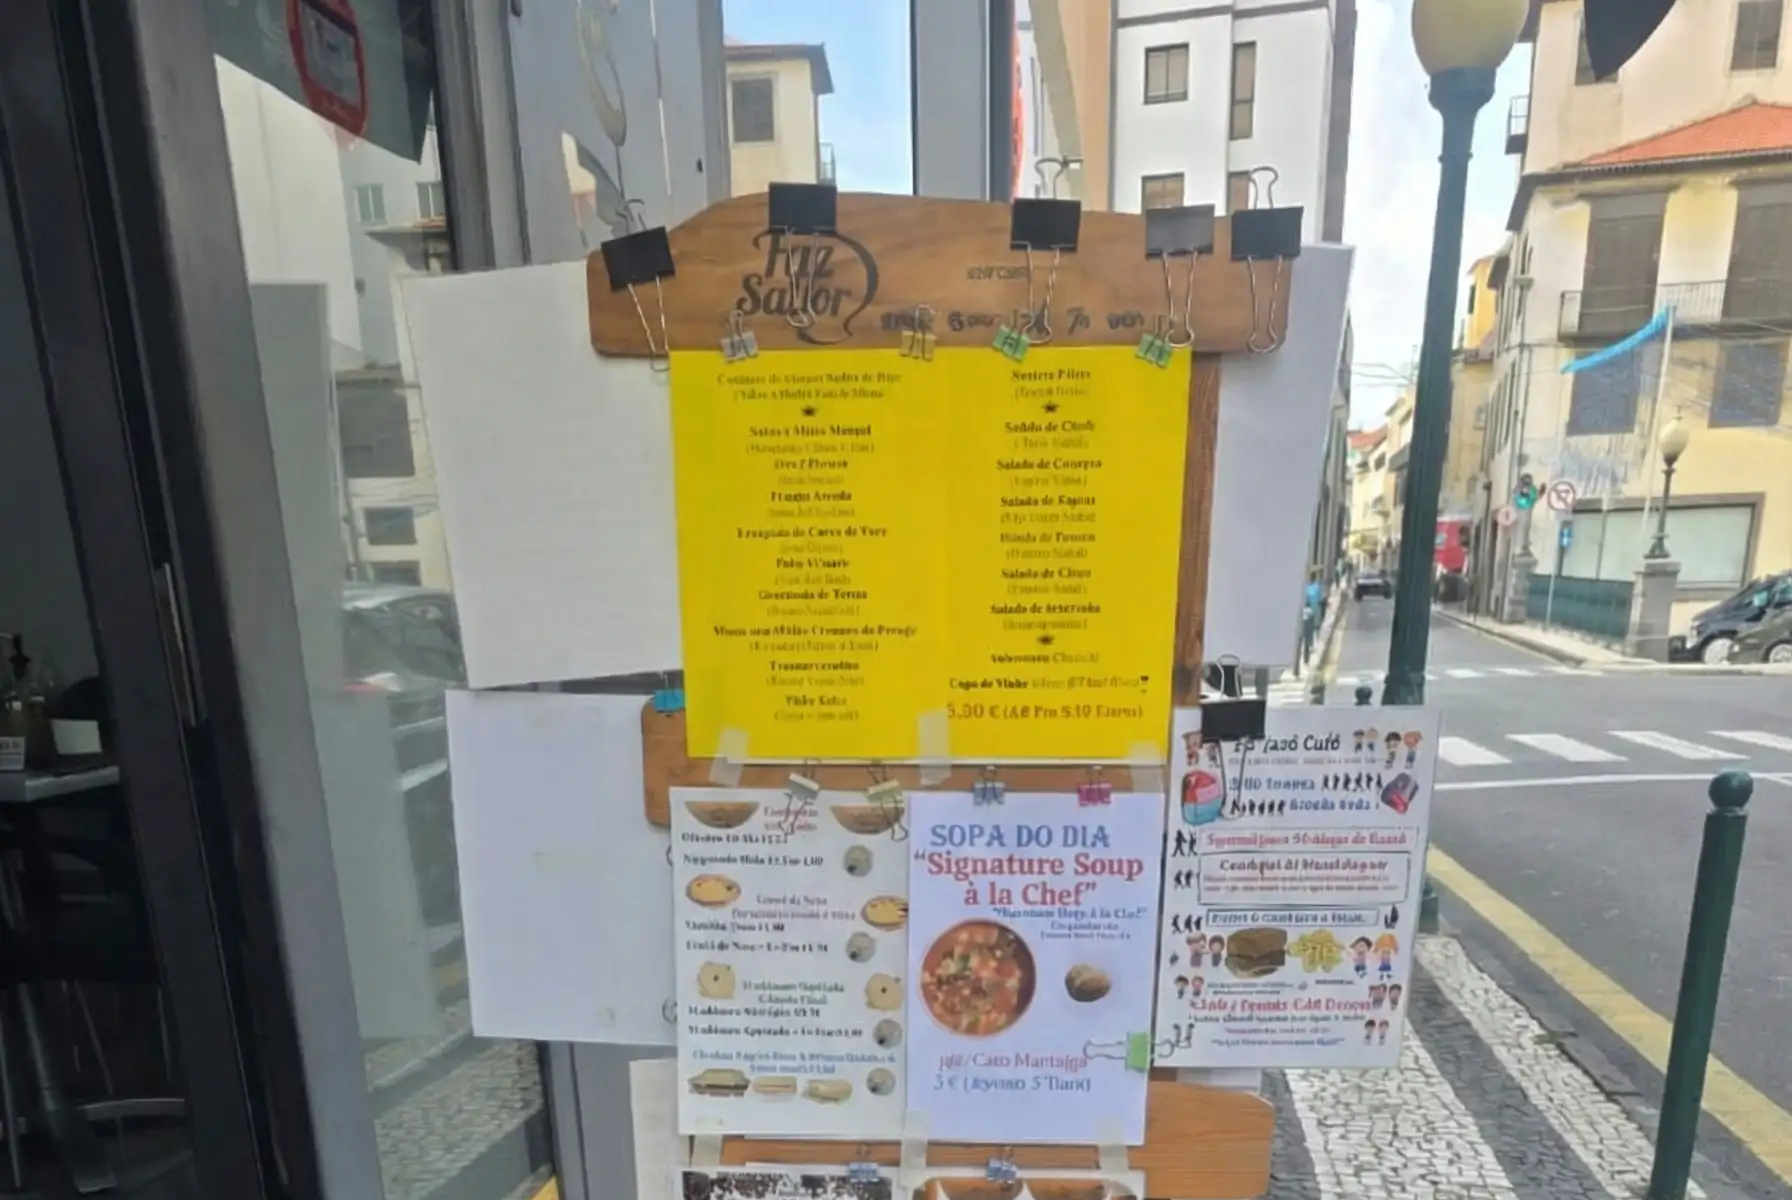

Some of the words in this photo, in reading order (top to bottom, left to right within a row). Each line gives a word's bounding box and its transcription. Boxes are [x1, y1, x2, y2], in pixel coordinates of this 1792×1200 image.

[929, 824, 1006, 848] SOPA
[1016, 824, 1053, 848] DO
[1062, 824, 1111, 848] DIA
[1073, 852, 1144, 881] Soup
[964, 881, 979, 907] à
[989, 881, 1013, 906] la
